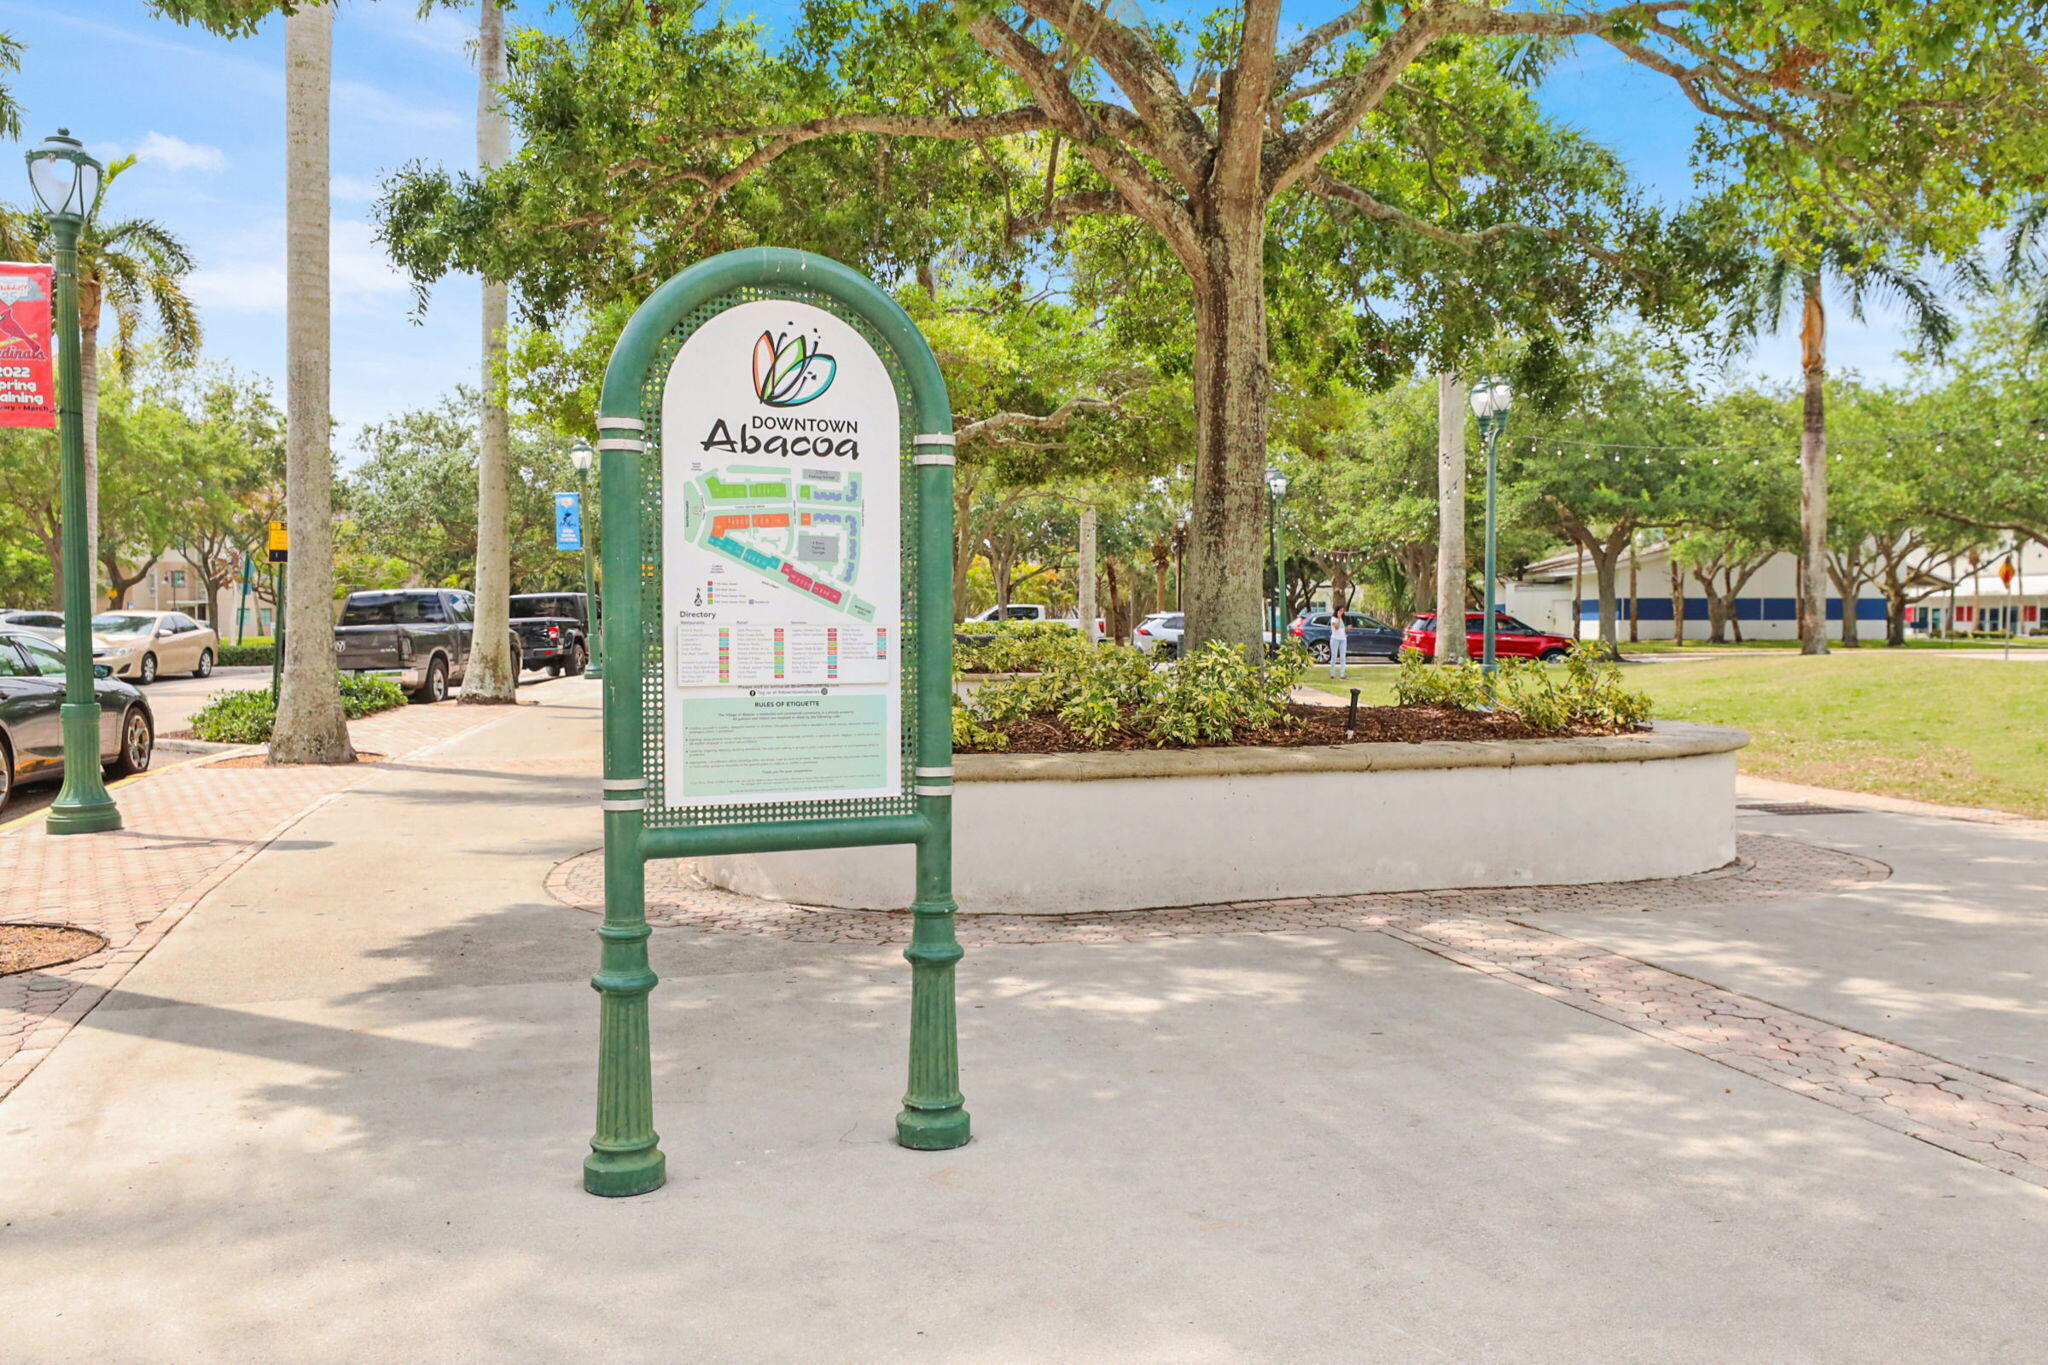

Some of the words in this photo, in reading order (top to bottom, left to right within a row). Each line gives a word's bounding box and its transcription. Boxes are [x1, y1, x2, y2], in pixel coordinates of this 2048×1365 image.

[0, 378, 37, 392] pring
[0, 391, 44, 406] aining
[752, 416, 858, 433] DOWNTOWN
[700, 418, 859, 460] Abacoa
[680, 610, 717, 620] Directory
